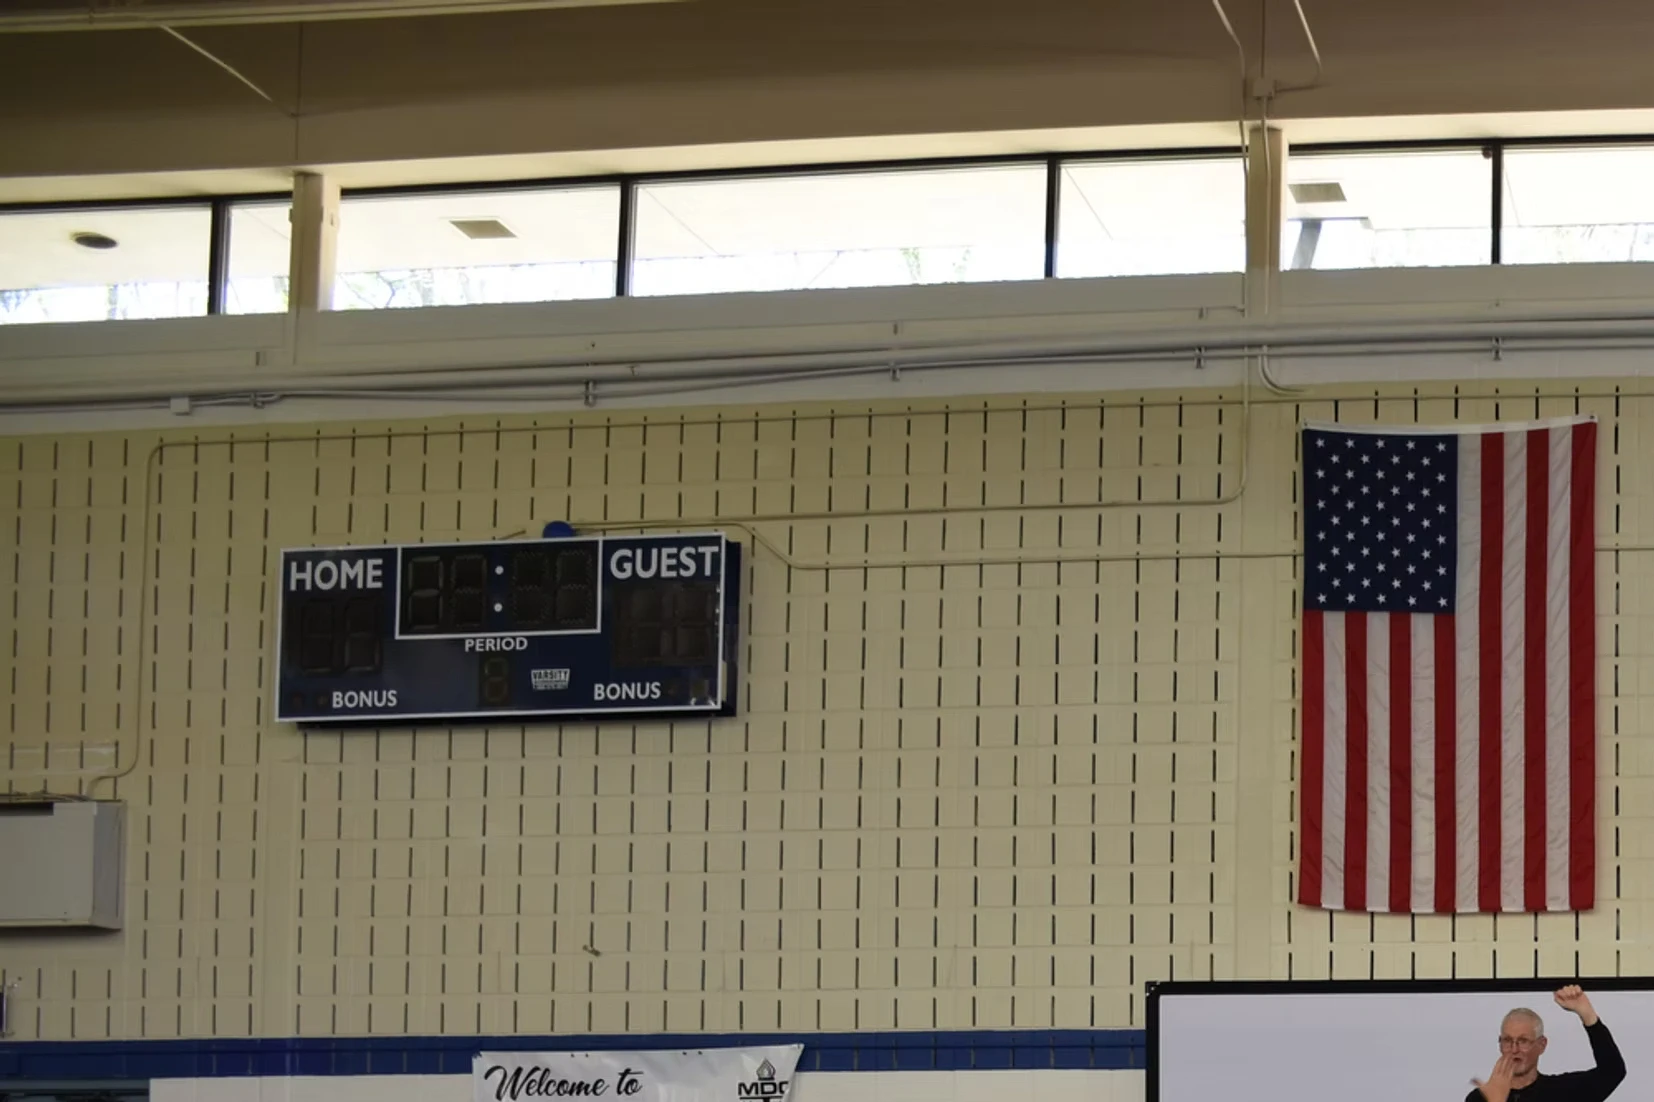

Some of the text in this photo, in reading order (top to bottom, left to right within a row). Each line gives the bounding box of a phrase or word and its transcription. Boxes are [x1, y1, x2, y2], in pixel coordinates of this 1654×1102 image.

[290, 559, 383, 591] HOME
[610, 546, 719, 579] GUEST
[464, 637, 528, 653] PERIOD
[332, 690, 398, 709] BONUS
[593, 682, 662, 701] BONUS
[484, 1065, 644, 1102] Welcome to
